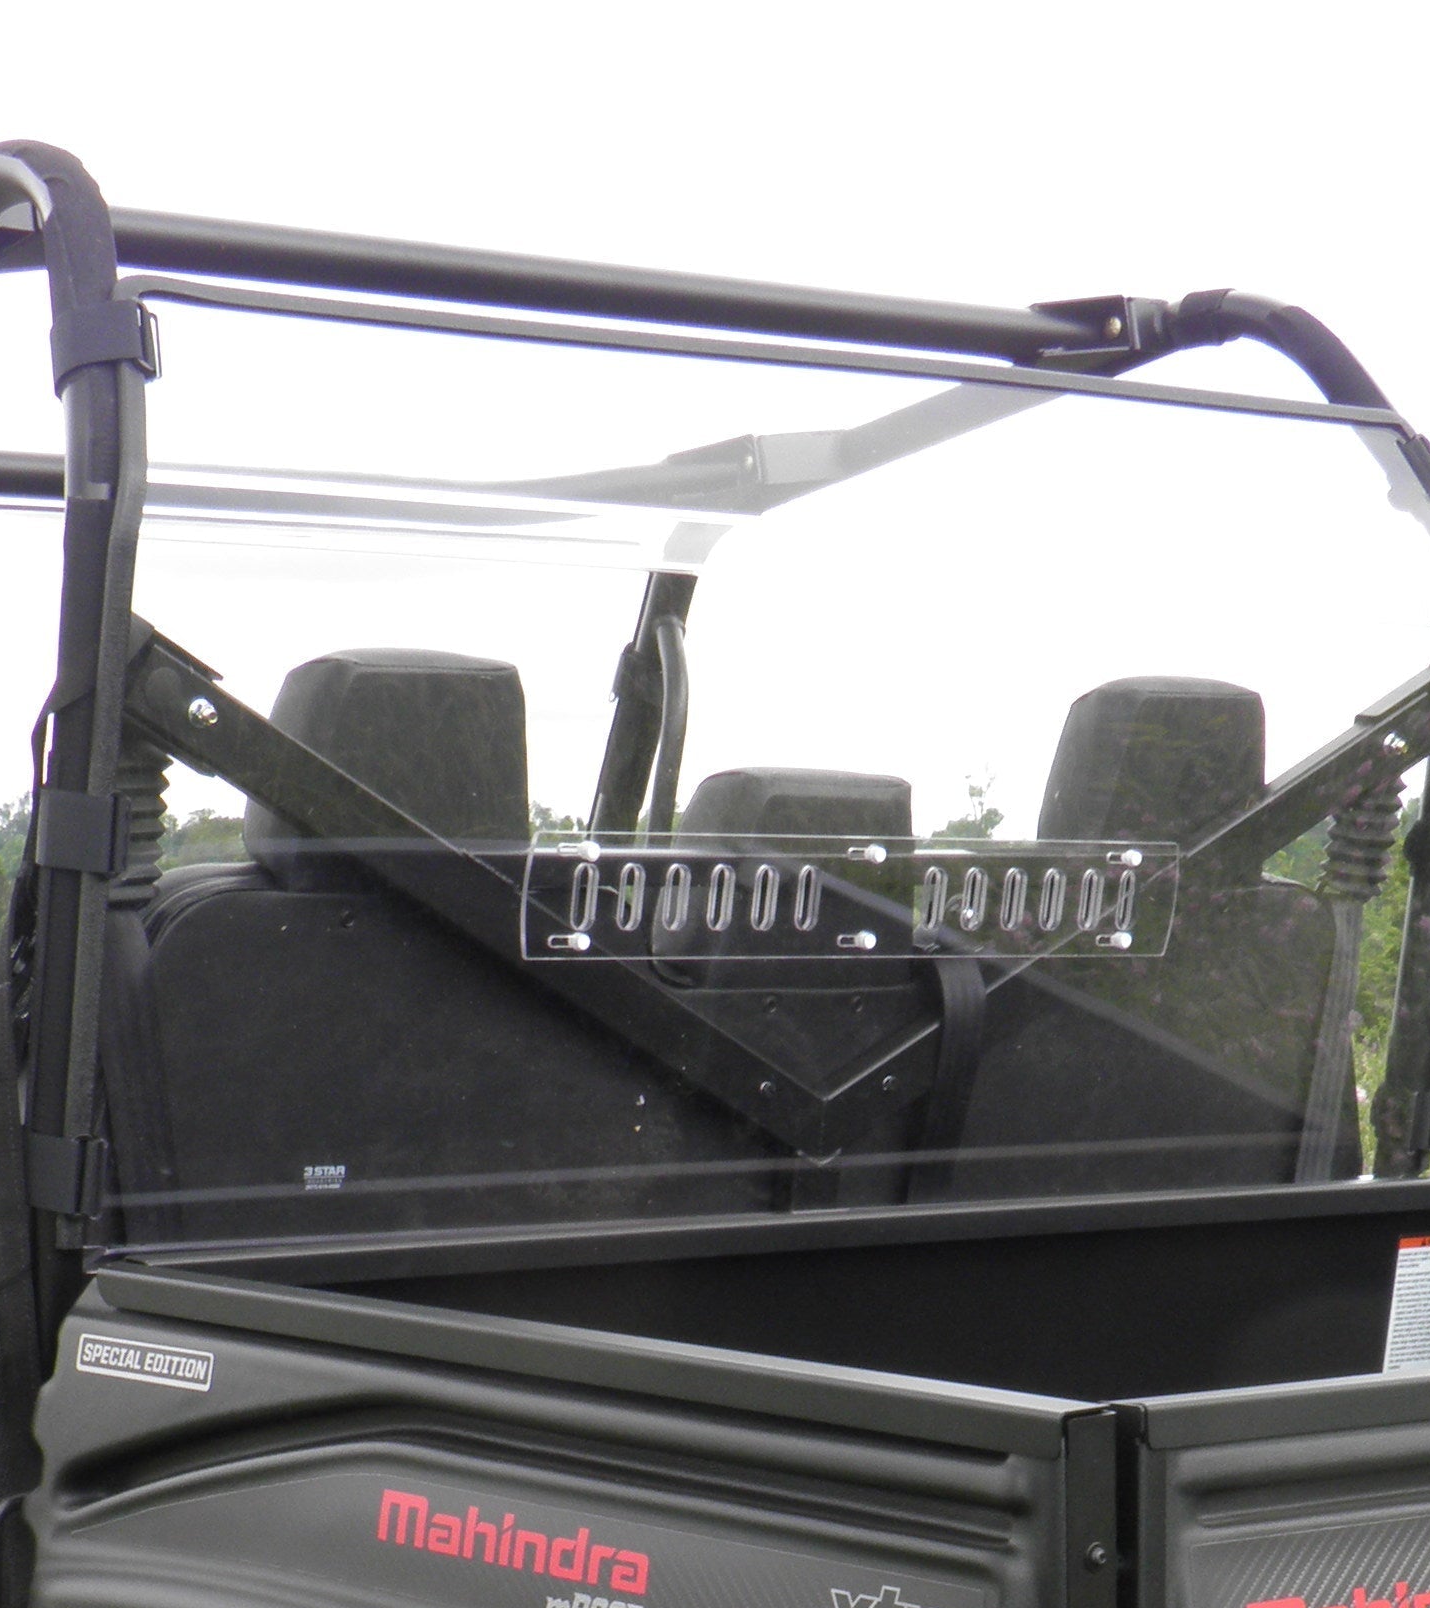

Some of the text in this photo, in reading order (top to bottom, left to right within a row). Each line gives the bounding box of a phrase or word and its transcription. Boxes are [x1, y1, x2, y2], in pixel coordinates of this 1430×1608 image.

[314, 1165, 345, 1176] STAR
[83, 1342, 208, 1380] SPECIAL EDITION
[377, 1489, 649, 1595] Mahindra
